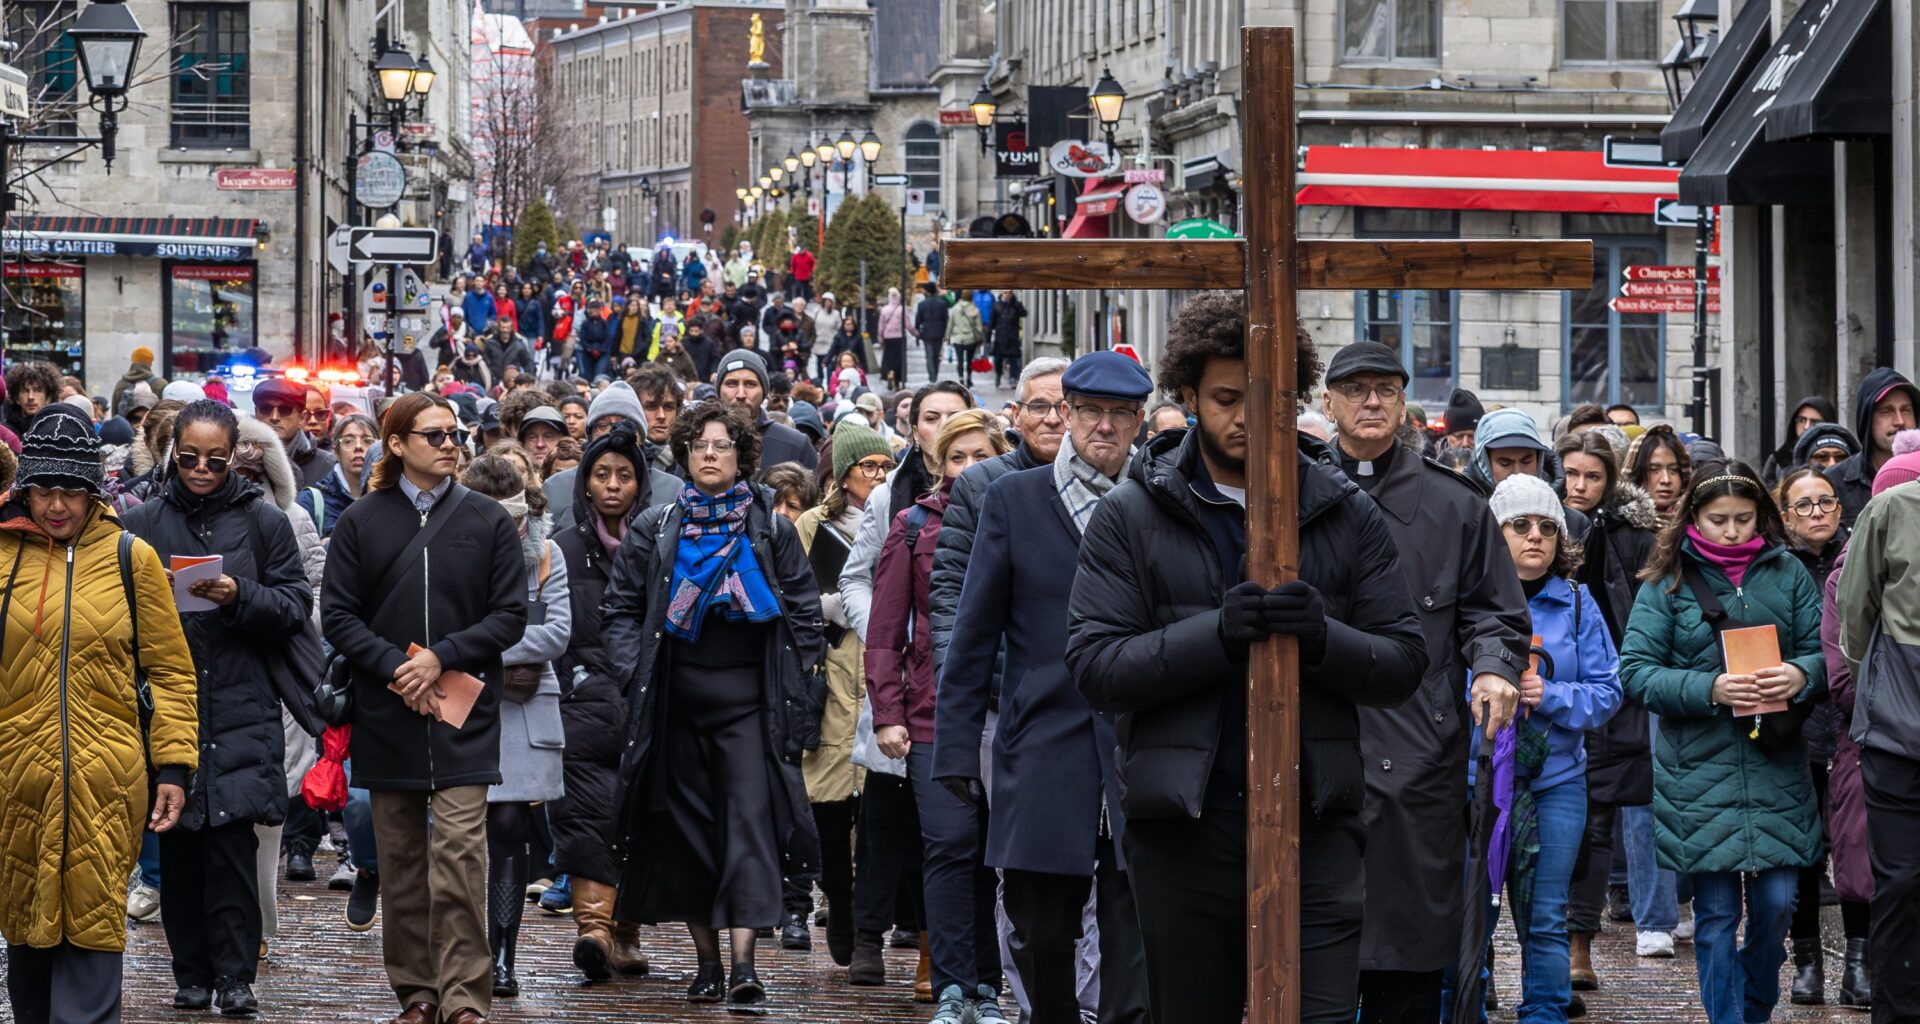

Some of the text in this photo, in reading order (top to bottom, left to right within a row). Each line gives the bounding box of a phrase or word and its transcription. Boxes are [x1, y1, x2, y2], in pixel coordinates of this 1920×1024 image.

[998, 152, 1039, 163] YUMI
[54, 240, 116, 253] CARTIER
[157, 244, 240, 257] SOUVENIRS
